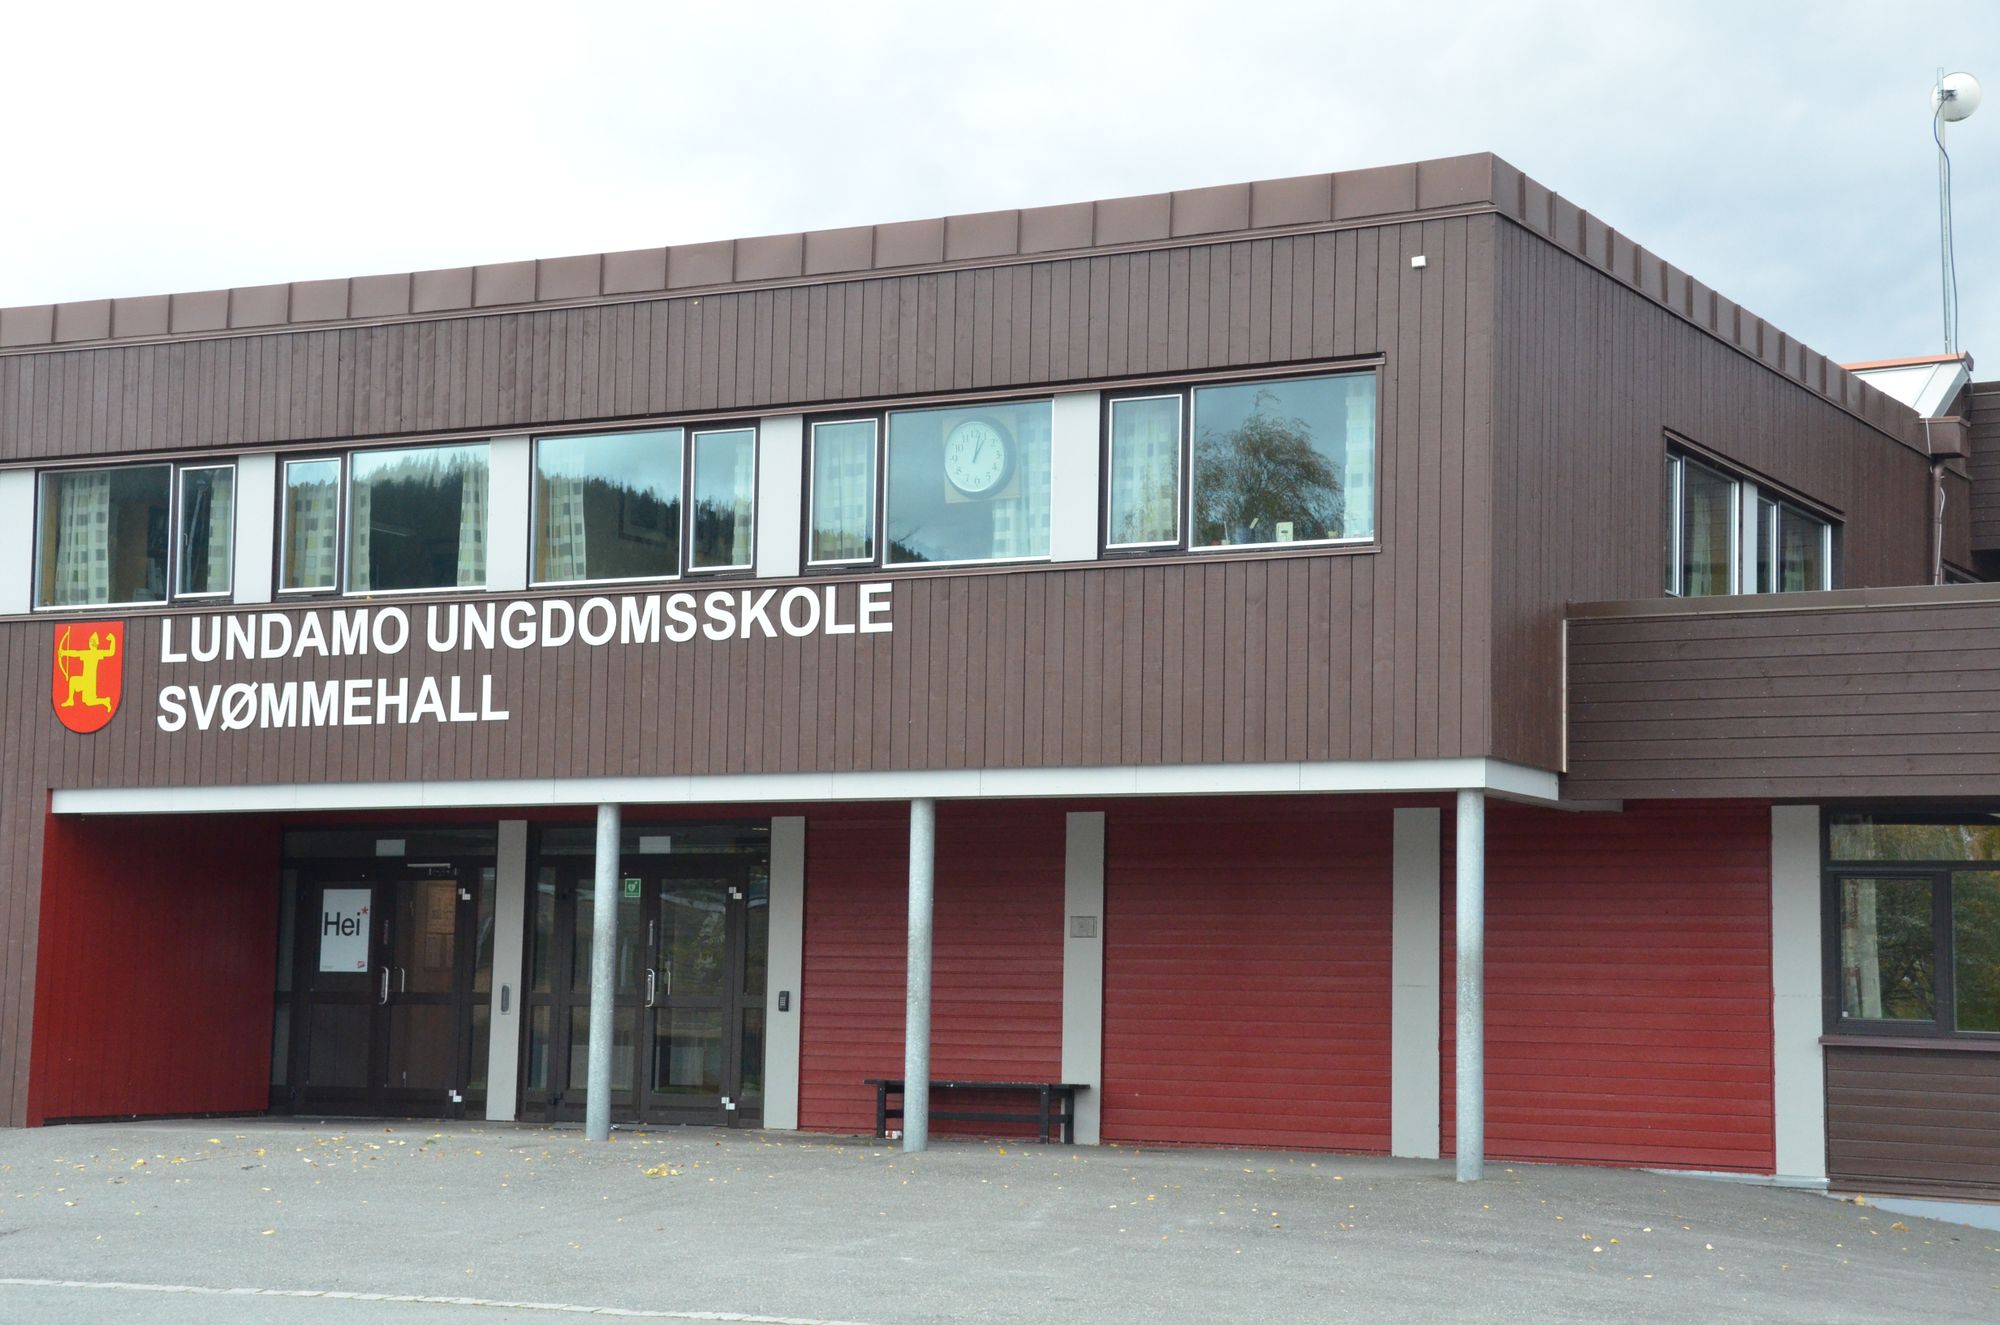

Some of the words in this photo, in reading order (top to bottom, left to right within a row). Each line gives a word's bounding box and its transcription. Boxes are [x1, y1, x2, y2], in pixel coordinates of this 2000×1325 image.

[161, 606, 410, 663] LUNDAMO
[427, 582, 893, 653] UNGDOMSSKOLE
[157, 674, 510, 732] SVØMMEHALL
